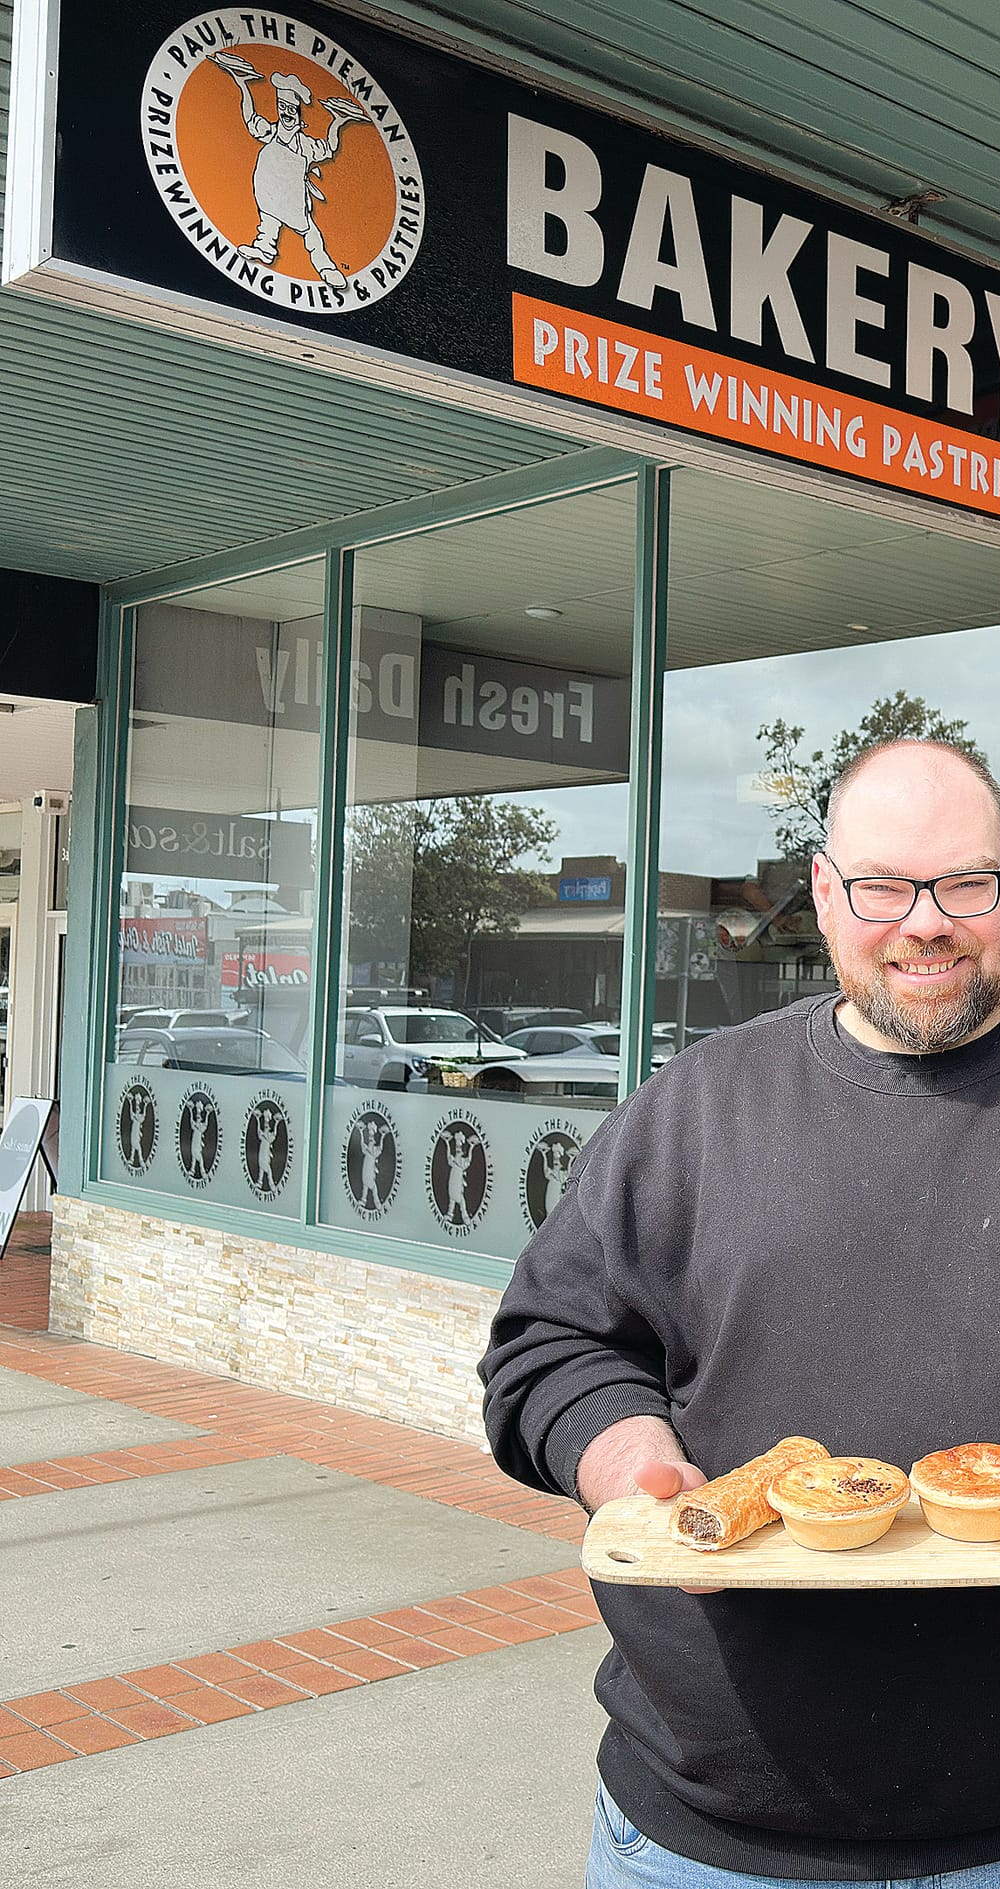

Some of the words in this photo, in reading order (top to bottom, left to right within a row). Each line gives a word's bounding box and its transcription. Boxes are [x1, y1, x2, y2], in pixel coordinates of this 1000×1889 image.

[167, 17, 232, 68] PAUL
[241, 14, 296, 46] THE
[312, 36, 405, 143] PIEMAN
[290, 282, 344, 308] PIES
[354, 279, 371, 301] &
[370, 175, 420, 288] PASTRIES
[533, 317, 663, 400] PRIZE
[683, 363, 866, 458] WINNING
